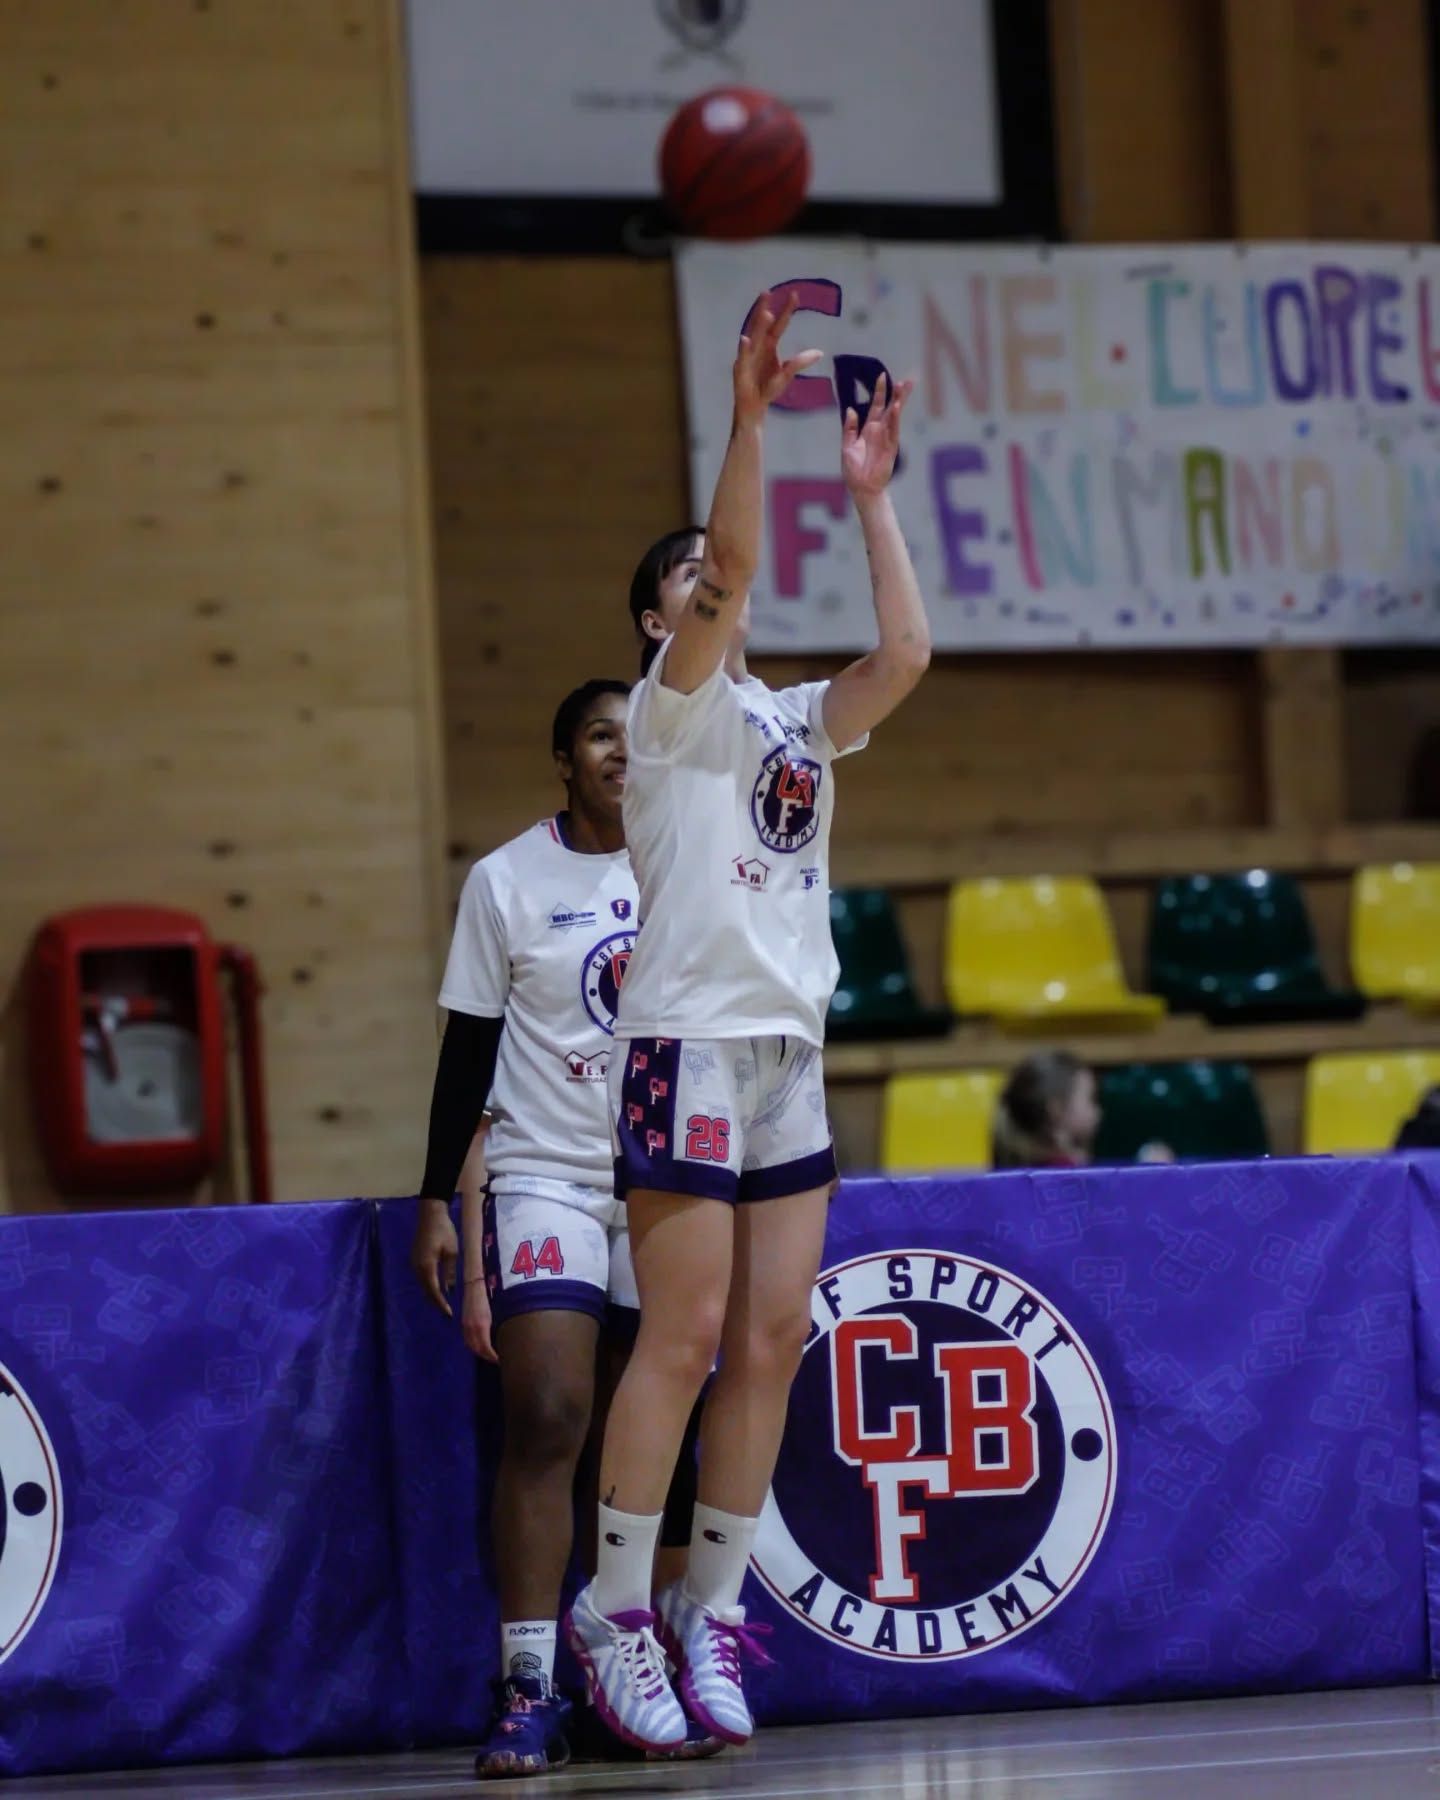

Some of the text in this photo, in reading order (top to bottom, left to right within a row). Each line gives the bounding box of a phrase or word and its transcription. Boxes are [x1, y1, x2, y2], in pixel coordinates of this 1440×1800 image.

[1146, 266, 1411, 405] CUORE
[686, 1115, 730, 1162] 26
[511, 1236, 564, 1279] 44
[886, 1256, 1075, 1360] SPORT
[829, 1313, 1040, 1604] CBF
[788, 1555, 1062, 1654] ACADEMY
